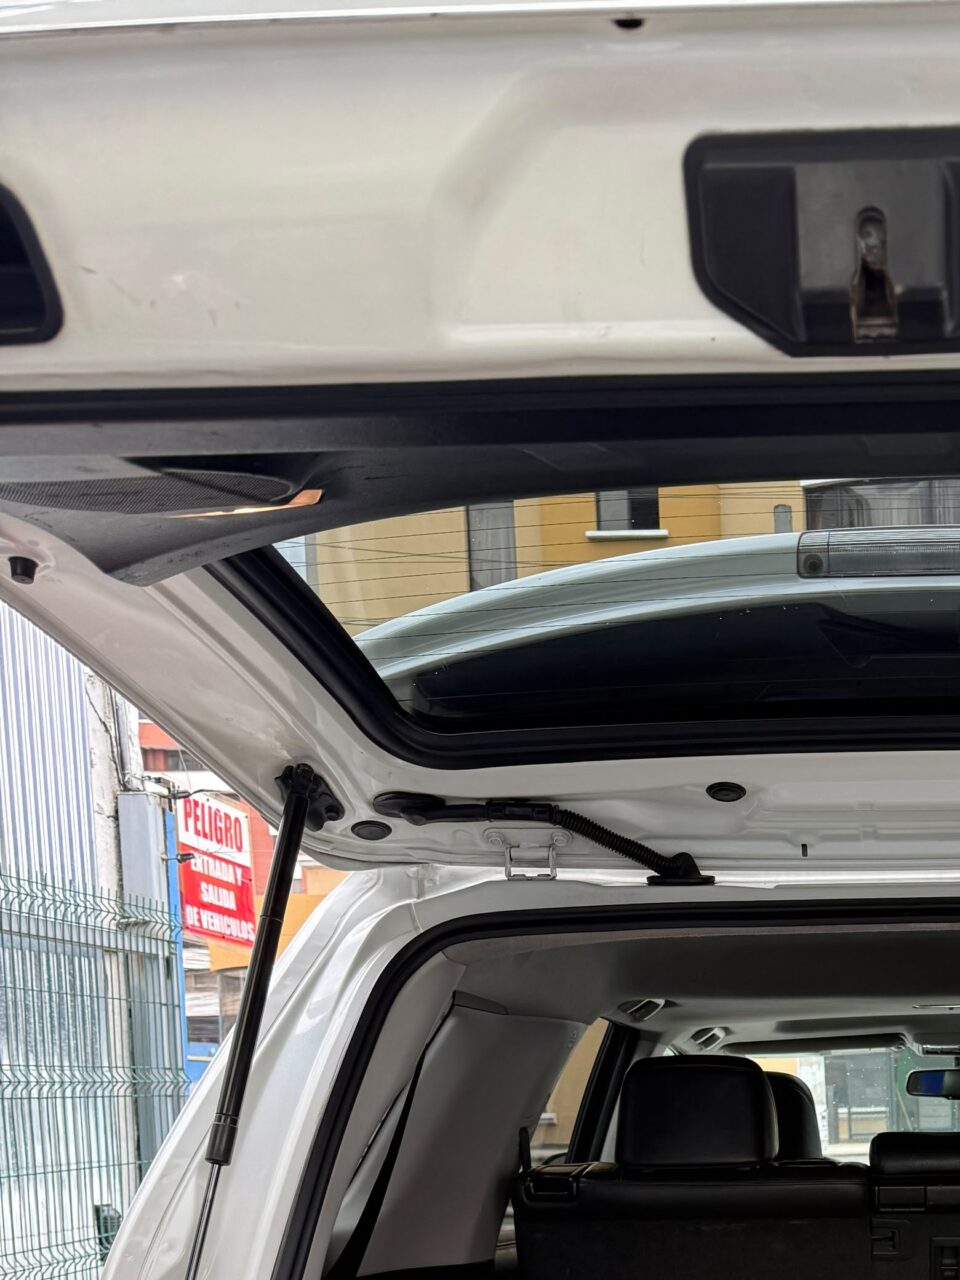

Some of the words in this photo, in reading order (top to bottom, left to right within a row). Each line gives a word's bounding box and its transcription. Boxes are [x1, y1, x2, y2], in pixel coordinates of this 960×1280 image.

[183, 797, 243, 852] PELIGRO
[190, 852, 236, 885] ENTRADA
[235, 866, 243, 886] Y
[201, 882, 237, 911] SALIDA
[185, 904, 200, 927] DE
[200, 908, 255, 942] VEHICULOS
